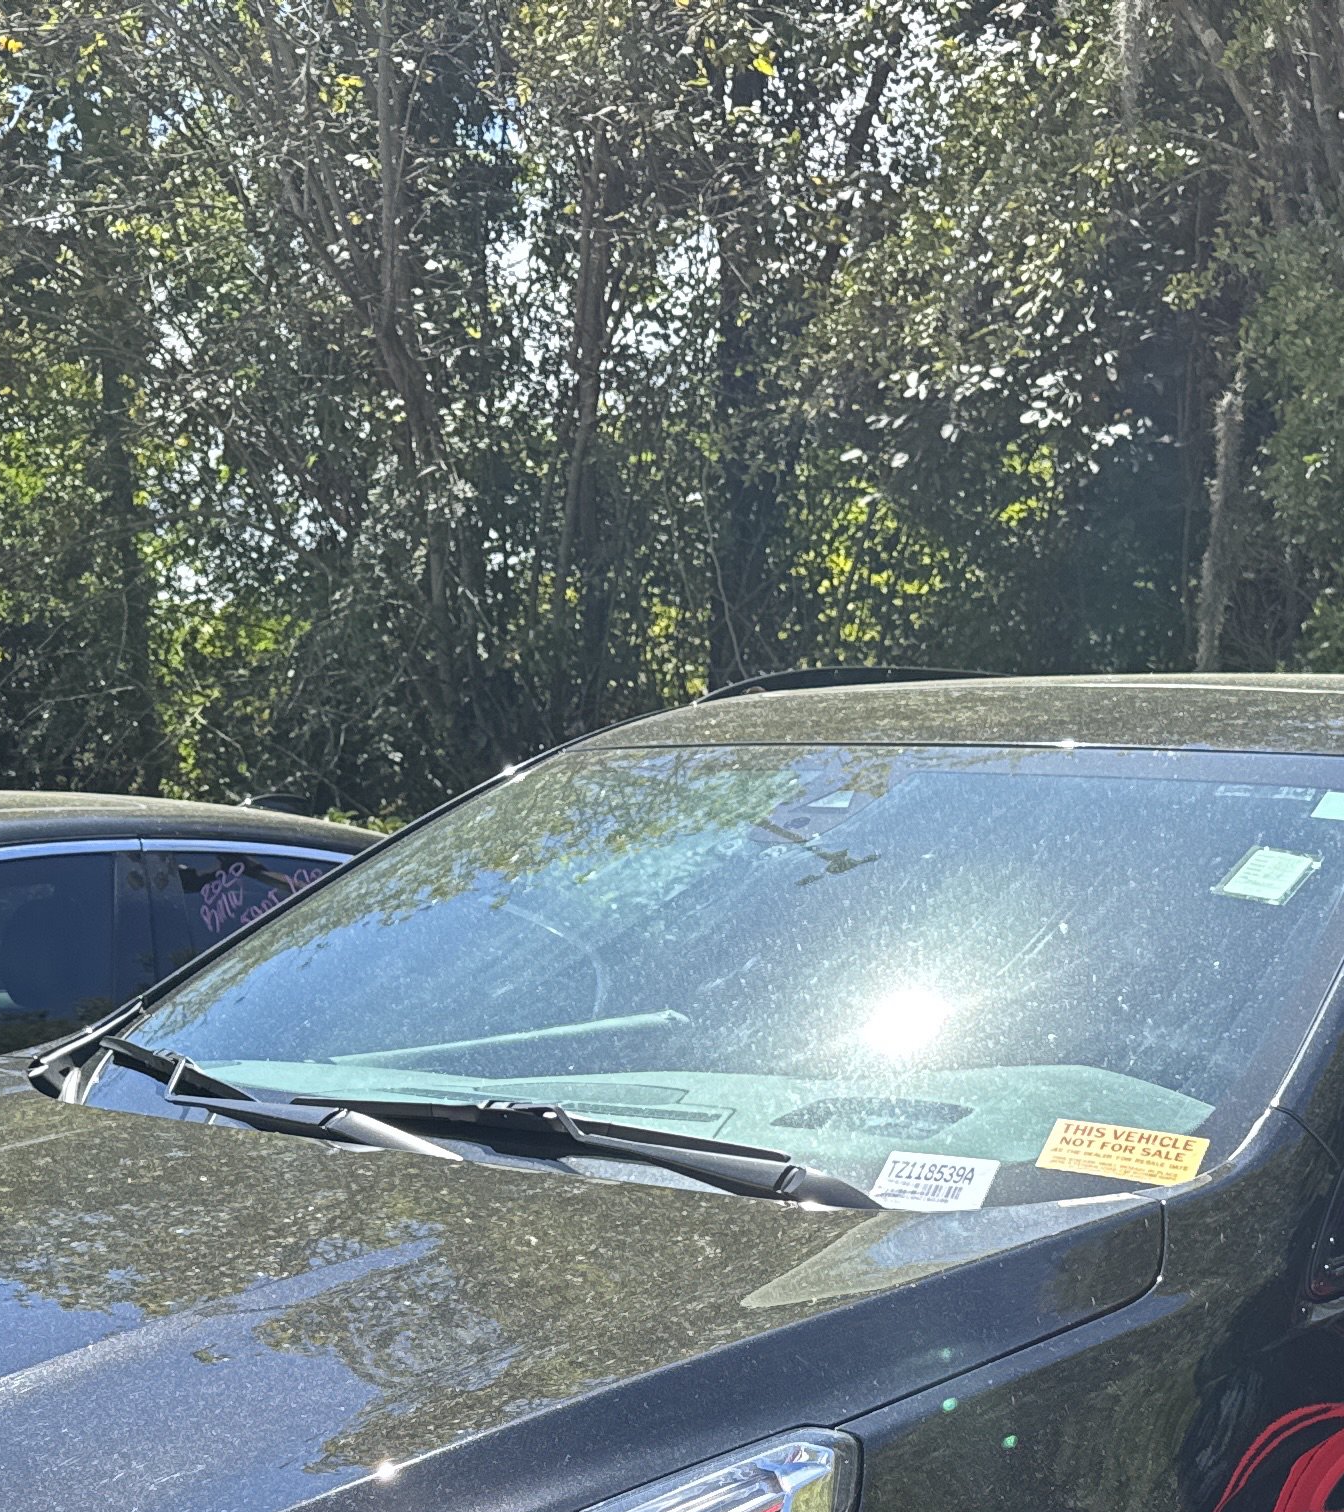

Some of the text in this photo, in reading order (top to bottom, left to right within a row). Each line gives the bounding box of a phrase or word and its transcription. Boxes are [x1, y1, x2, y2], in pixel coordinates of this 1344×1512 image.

[1059, 1136, 1186, 1162] NOT FOR SALE
[1062, 1123, 1197, 1151] THIS VEHICLE
[887, 1160, 975, 1186] TZ118539A
